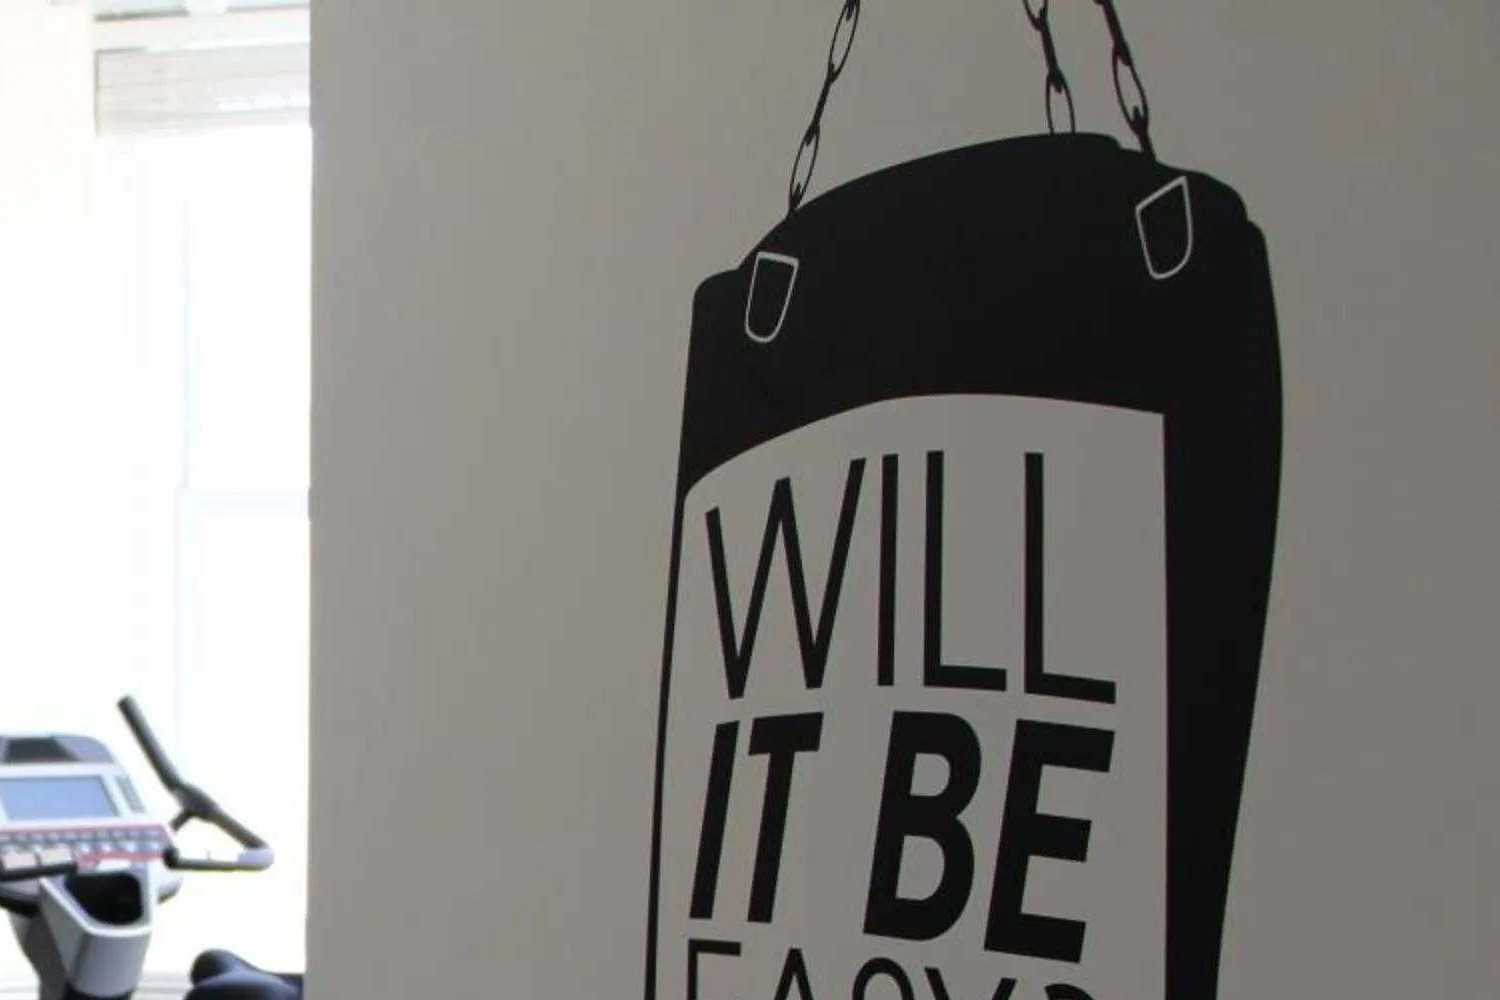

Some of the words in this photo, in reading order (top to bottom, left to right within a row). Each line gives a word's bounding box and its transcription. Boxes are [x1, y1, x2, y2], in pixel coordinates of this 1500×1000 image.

[705, 450, 1116, 705] WILL
[689, 711, 824, 924] IT
[863, 710, 1115, 963] BE
